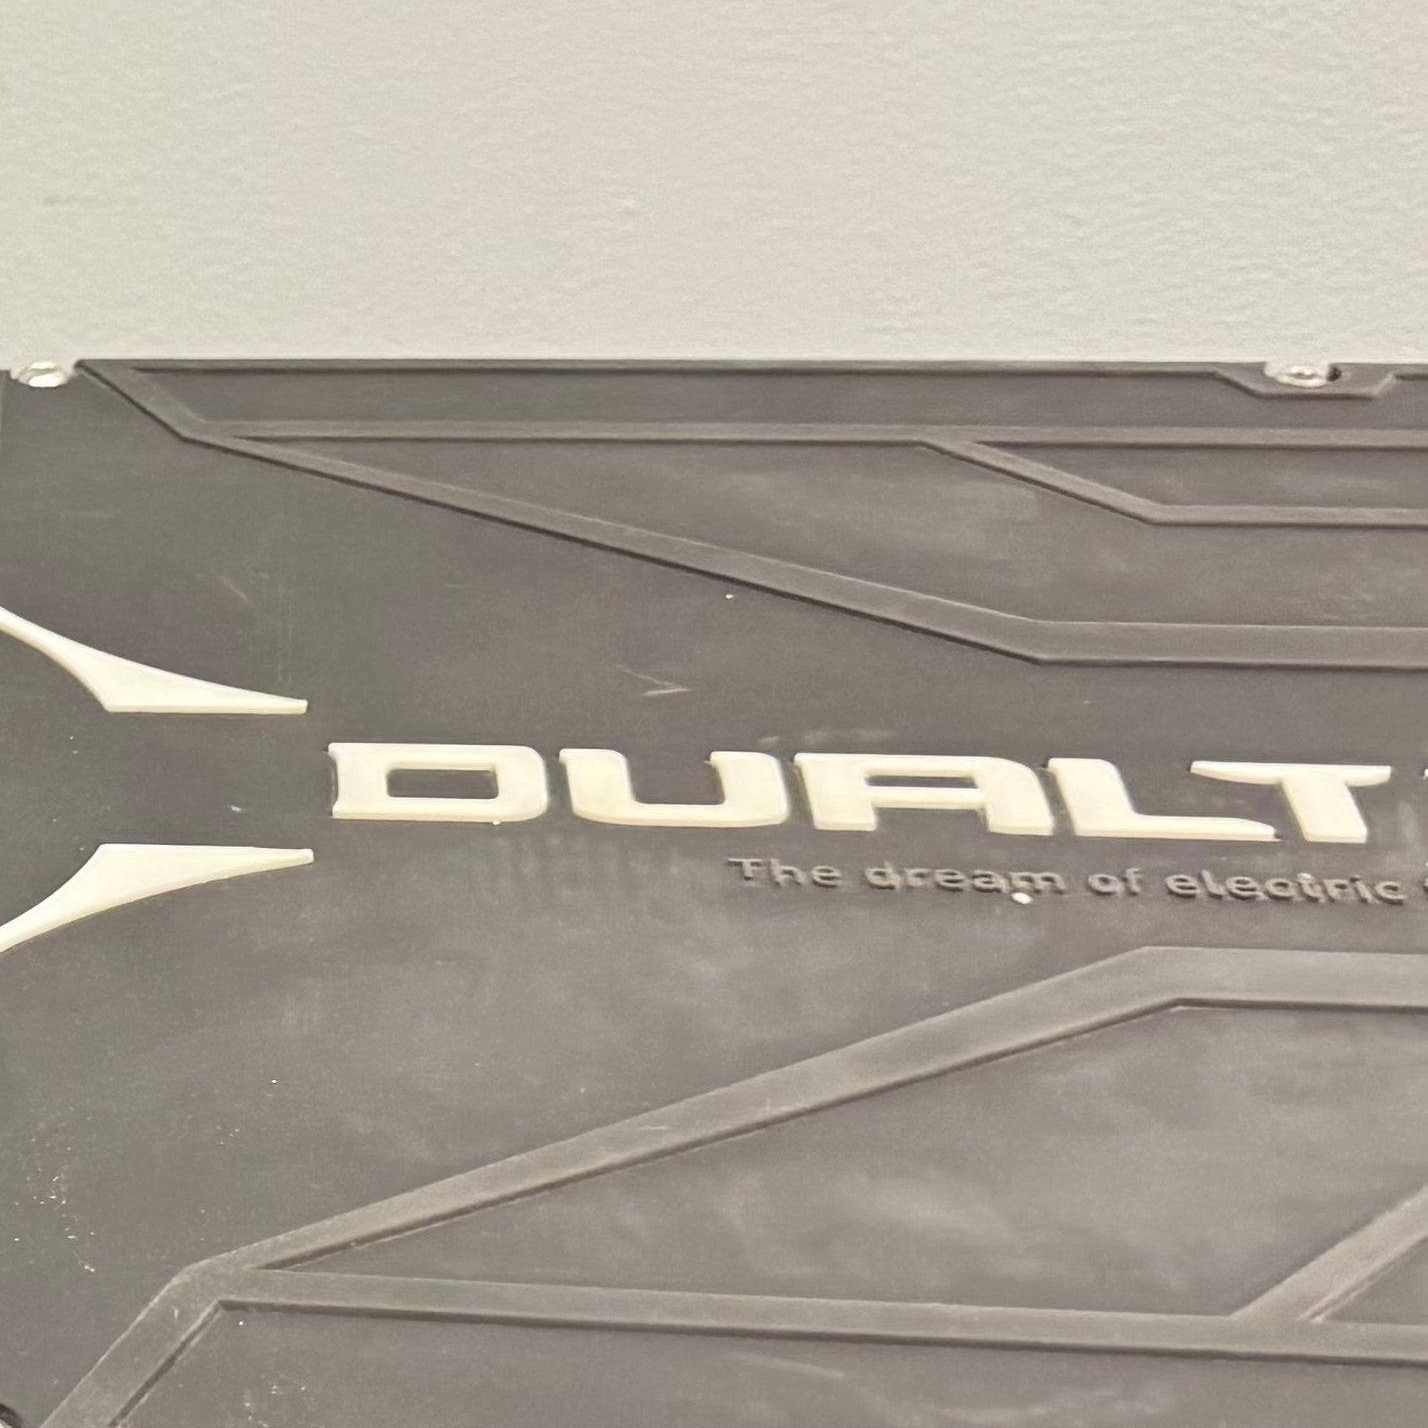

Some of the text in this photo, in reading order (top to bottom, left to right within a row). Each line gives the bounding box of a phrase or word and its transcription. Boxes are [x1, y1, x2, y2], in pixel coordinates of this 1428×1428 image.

[328, 742, 1428, 846] DUALT
[728, 857, 1409, 906] The dream of electric
